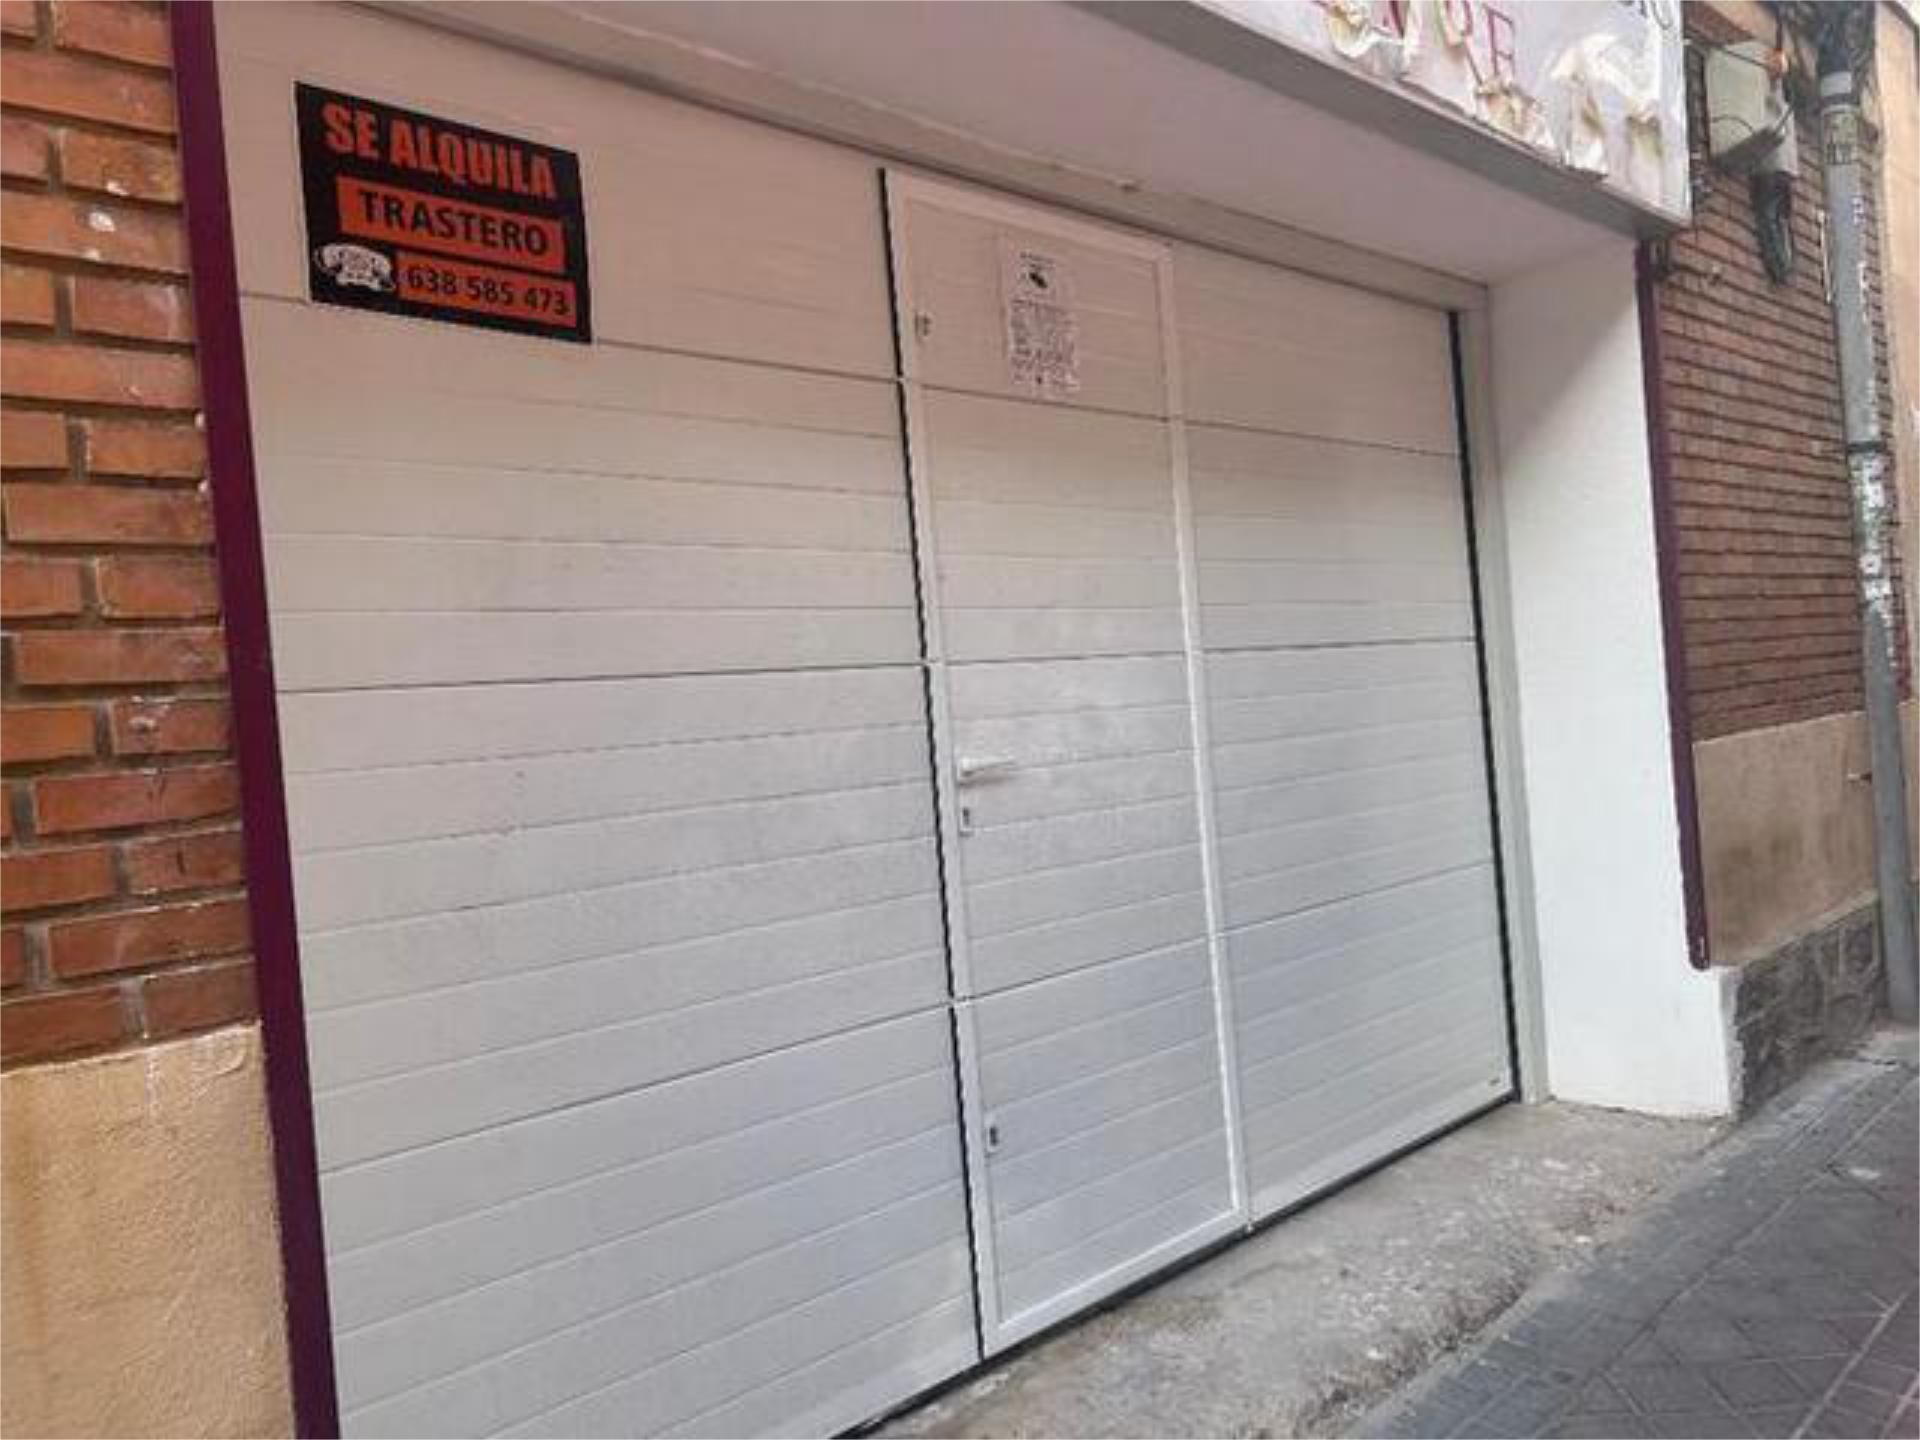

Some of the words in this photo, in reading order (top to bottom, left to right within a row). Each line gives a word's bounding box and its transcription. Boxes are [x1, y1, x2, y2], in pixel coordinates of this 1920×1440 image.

[320, 102, 379, 159] SE
[389, 118, 558, 201] ALQUILA
[358, 190, 548, 256] TRASTERO
[407, 265, 458, 295] 638
[467, 275, 515, 305] 585
[523, 286, 571, 316] 473
